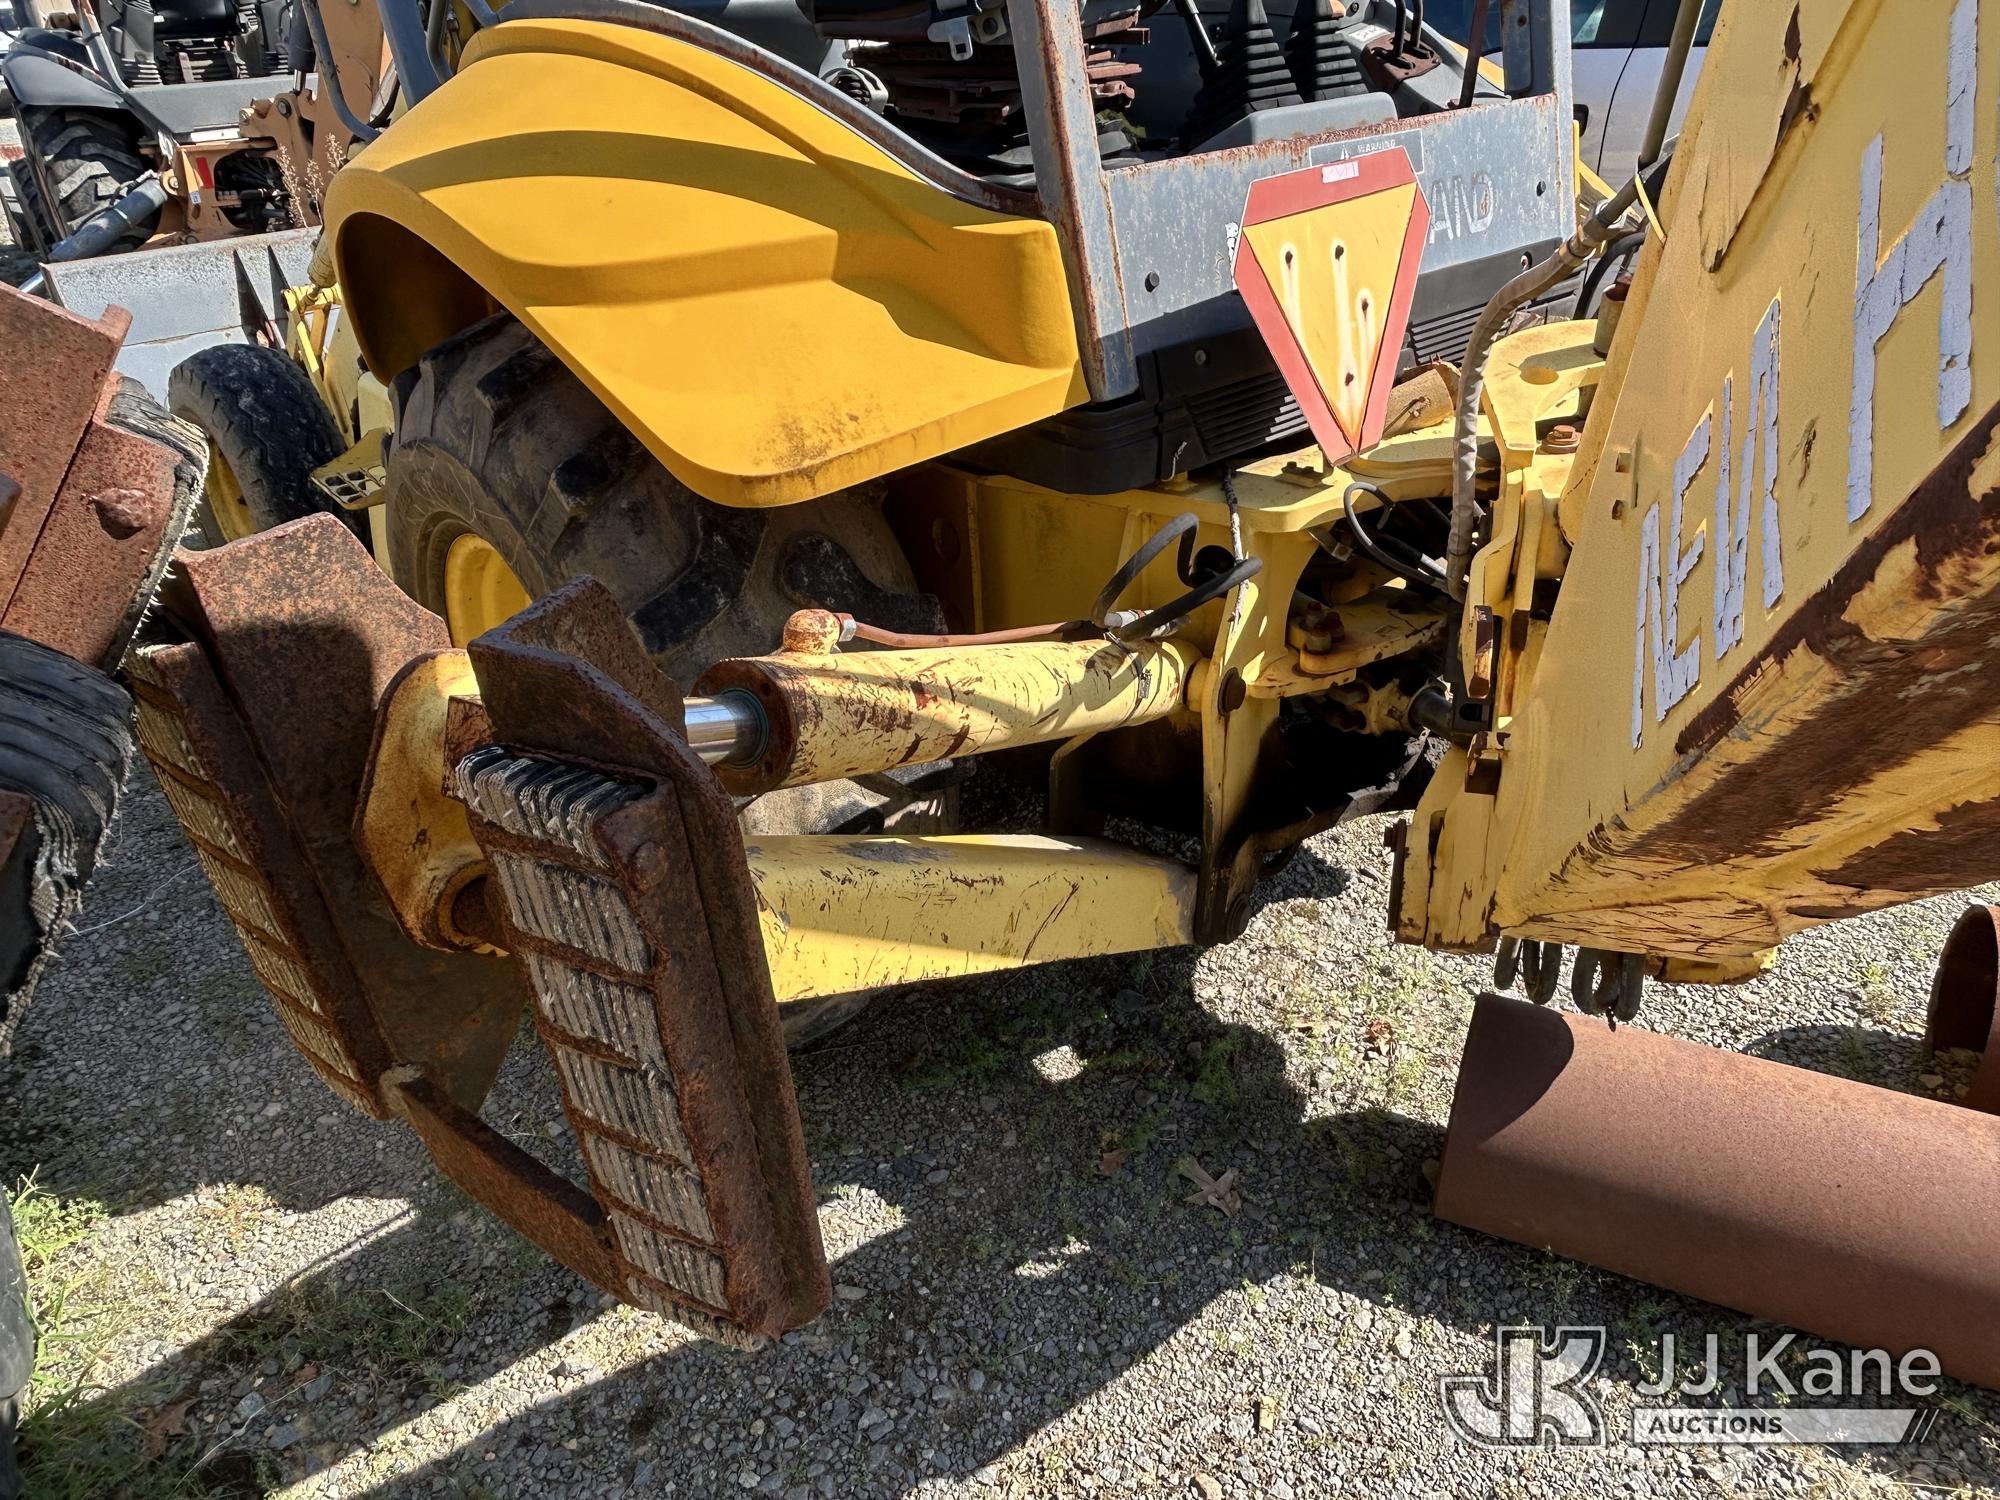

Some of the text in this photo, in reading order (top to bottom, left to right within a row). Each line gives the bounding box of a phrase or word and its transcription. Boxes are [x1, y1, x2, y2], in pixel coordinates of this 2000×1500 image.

[1357, 139, 1396, 153] WARNING
[1632, 0, 2000, 750] NEW H
